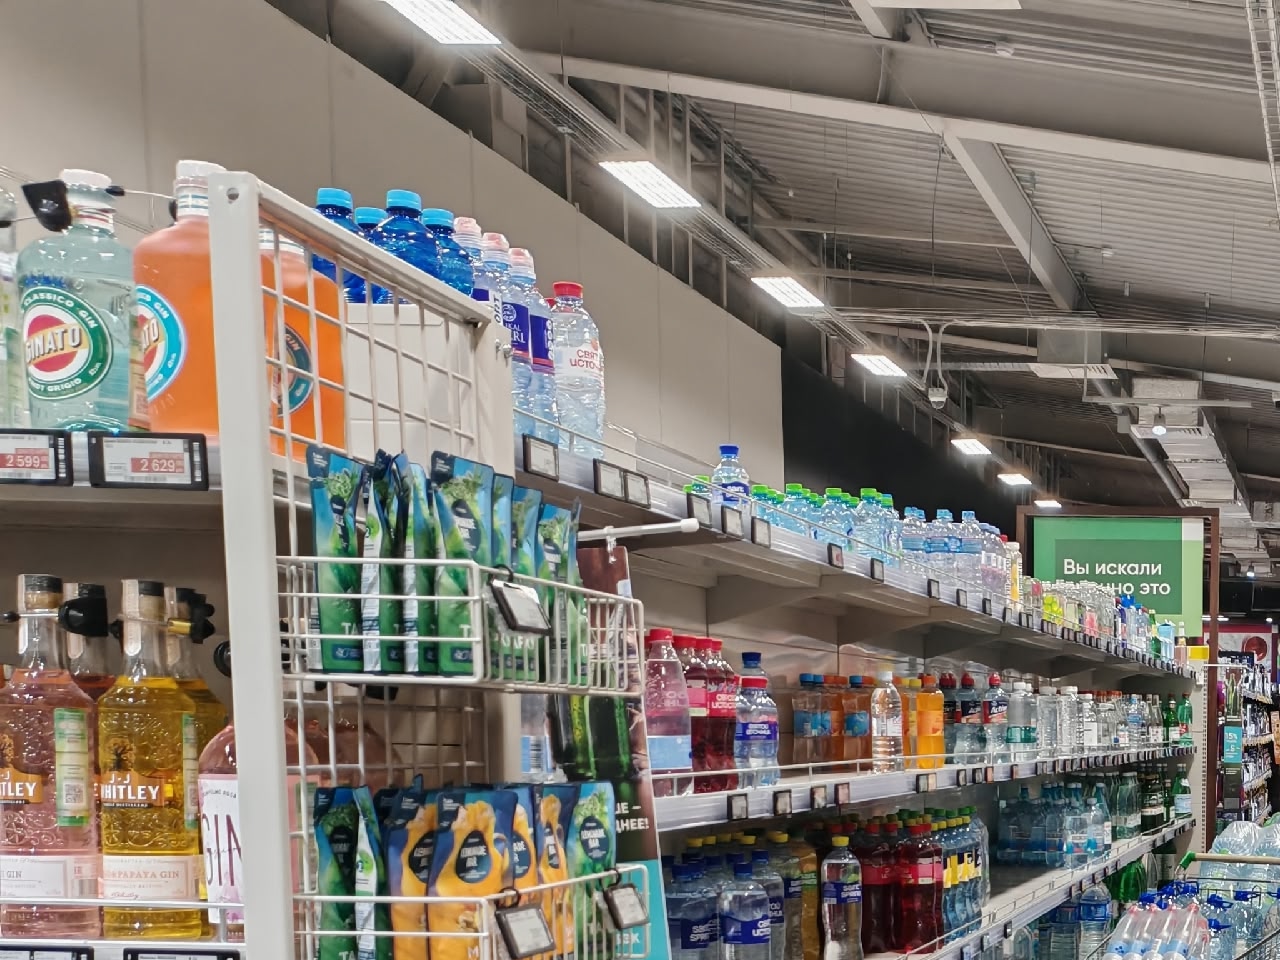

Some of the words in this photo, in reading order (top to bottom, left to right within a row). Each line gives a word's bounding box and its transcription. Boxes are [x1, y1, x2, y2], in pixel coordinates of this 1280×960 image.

[78, 309, 98, 330] GIN
[1063, 559, 1090, 577] Вы
[1095, 561, 1163, 576] искали
[1138, 582, 1171, 596] это
[160, 870, 180, 879] GIN
